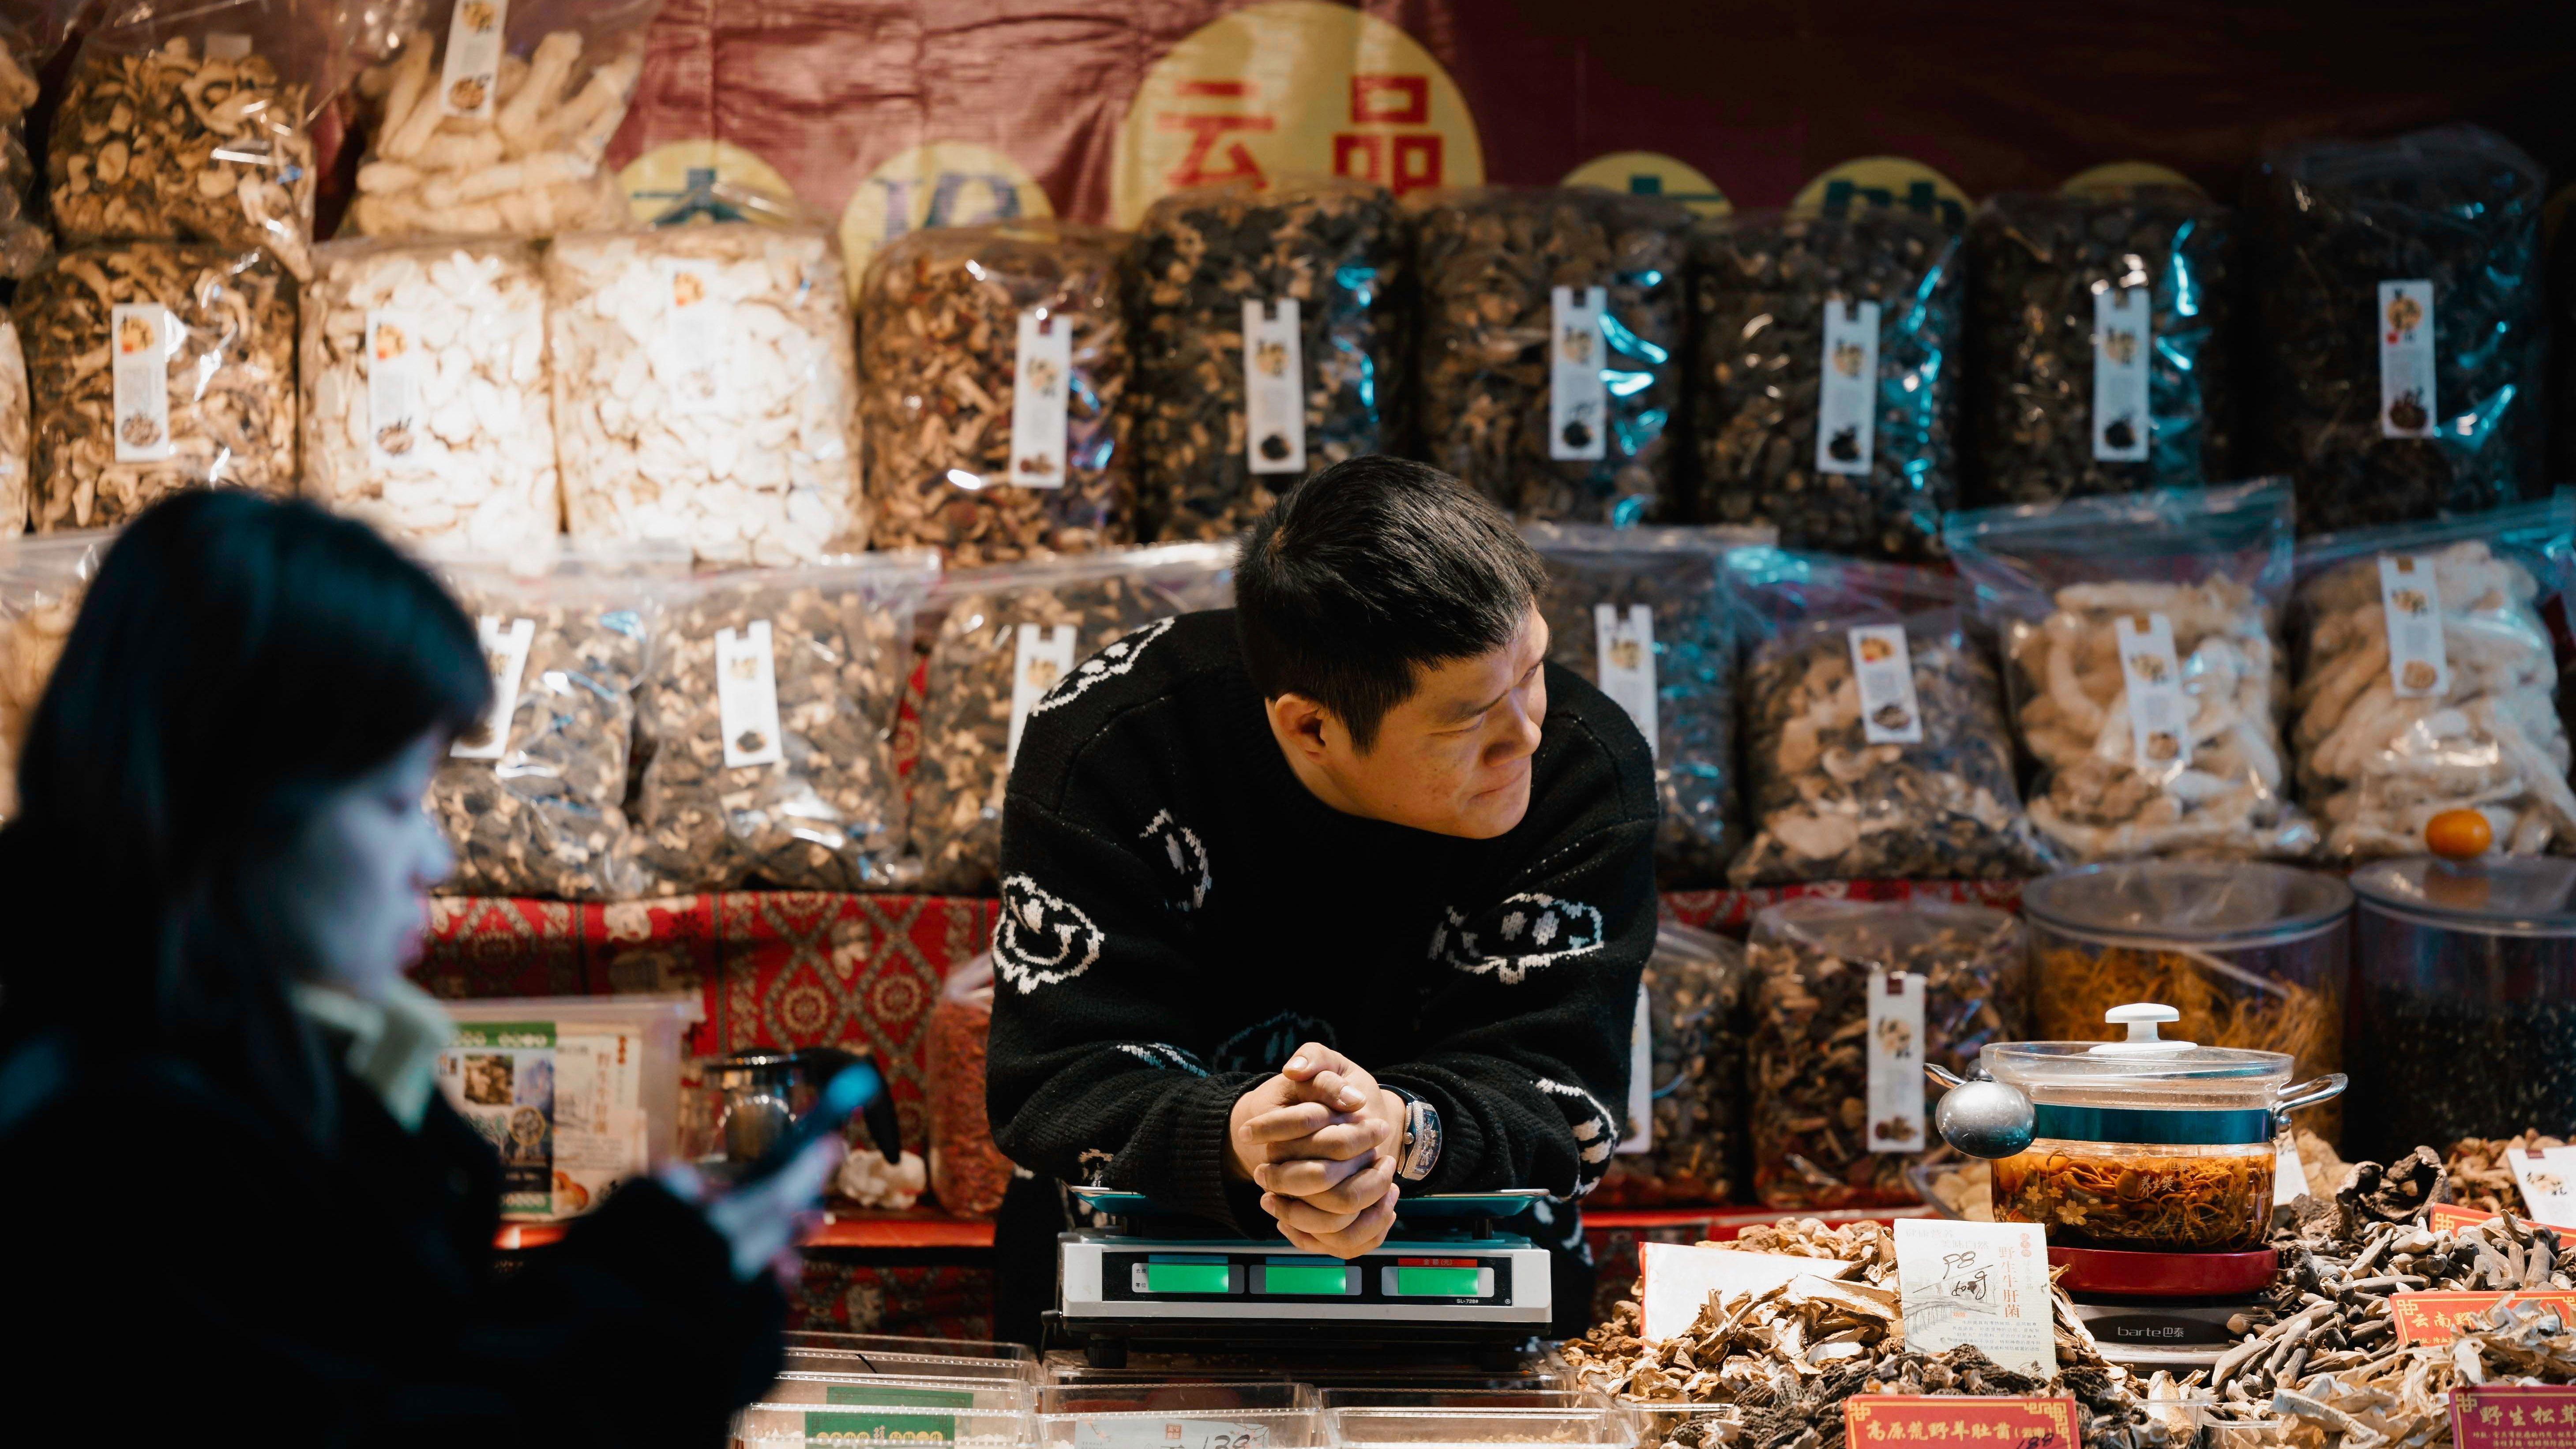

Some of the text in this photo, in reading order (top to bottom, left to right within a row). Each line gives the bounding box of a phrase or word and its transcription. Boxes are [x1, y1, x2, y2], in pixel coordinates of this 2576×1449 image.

[2139, 1175, 2175, 1198] 养生煲
[1998, 1246, 2020, 1318] 野生牛肝菌
[2411, 1310, 2472, 1328] 云南野
[2118, 1326, 2184, 1337] barte 巴泰
[2479, 1404, 2576, 1428] 野生松茸
